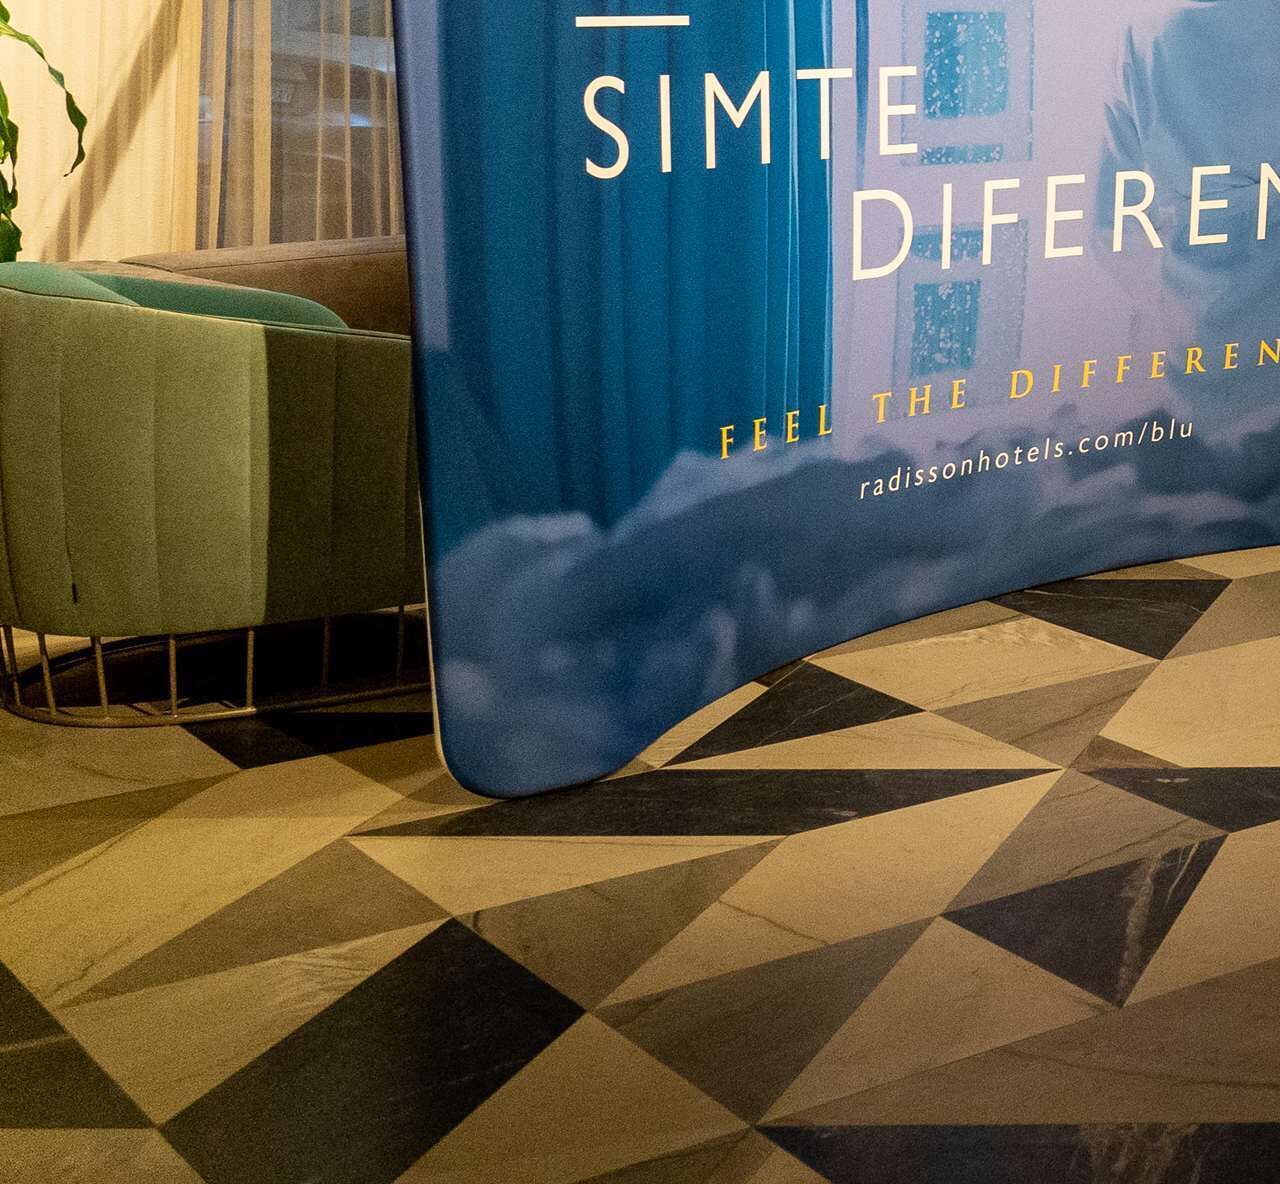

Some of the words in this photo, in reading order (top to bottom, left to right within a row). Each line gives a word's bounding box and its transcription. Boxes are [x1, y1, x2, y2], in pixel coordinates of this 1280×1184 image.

[583, 65, 919, 180] SIMTE
[719, 403, 833, 461] FEEL
[872, 377, 968, 424] THE
[858, 418, 1195, 500] radissonhotels.com/blu
